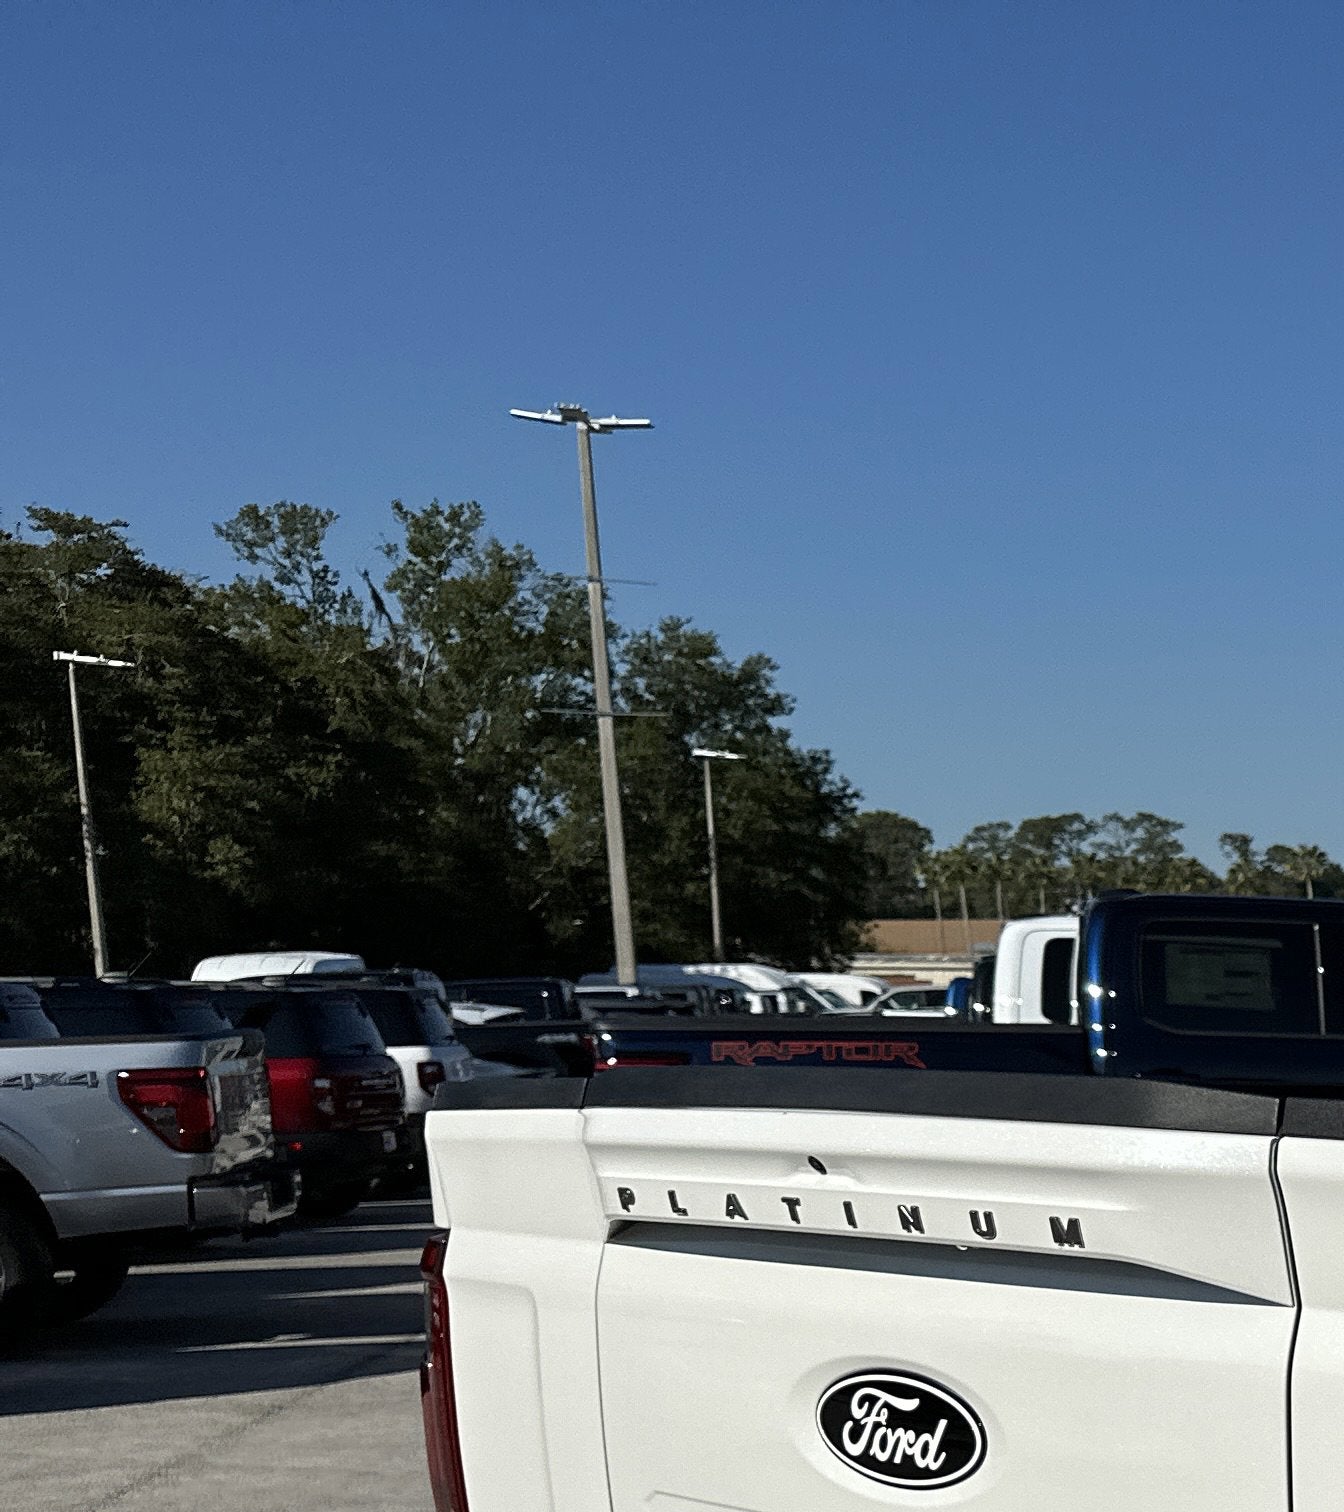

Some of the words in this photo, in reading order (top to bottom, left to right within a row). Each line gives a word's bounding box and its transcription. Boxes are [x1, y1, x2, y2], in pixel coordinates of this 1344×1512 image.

[711, 1040, 927, 1069] RAPTOR
[617, 1186, 1086, 1249] PLATINUM
[842, 1386, 948, 1470] Ford
